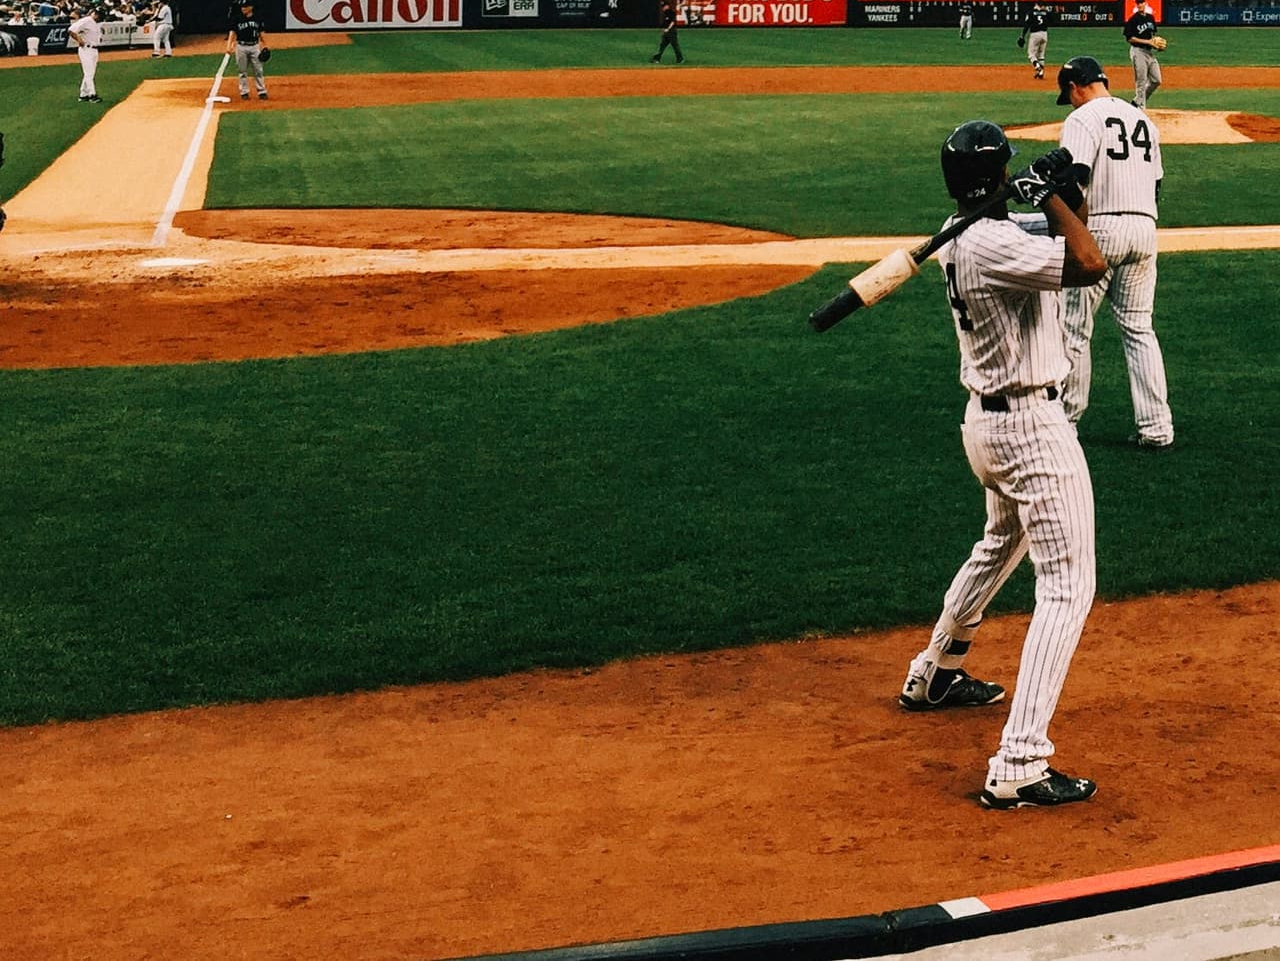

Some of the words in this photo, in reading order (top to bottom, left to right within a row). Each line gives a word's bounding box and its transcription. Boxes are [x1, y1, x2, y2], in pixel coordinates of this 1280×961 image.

[513, 1, 534, 10] ERA
[728, 3, 765, 23] FOR
[770, 4, 813, 23] YOU.
[1193, 12, 1229, 25] Experian
[1105, 117, 1151, 162] 34
[974, 188, 986, 197] 24
